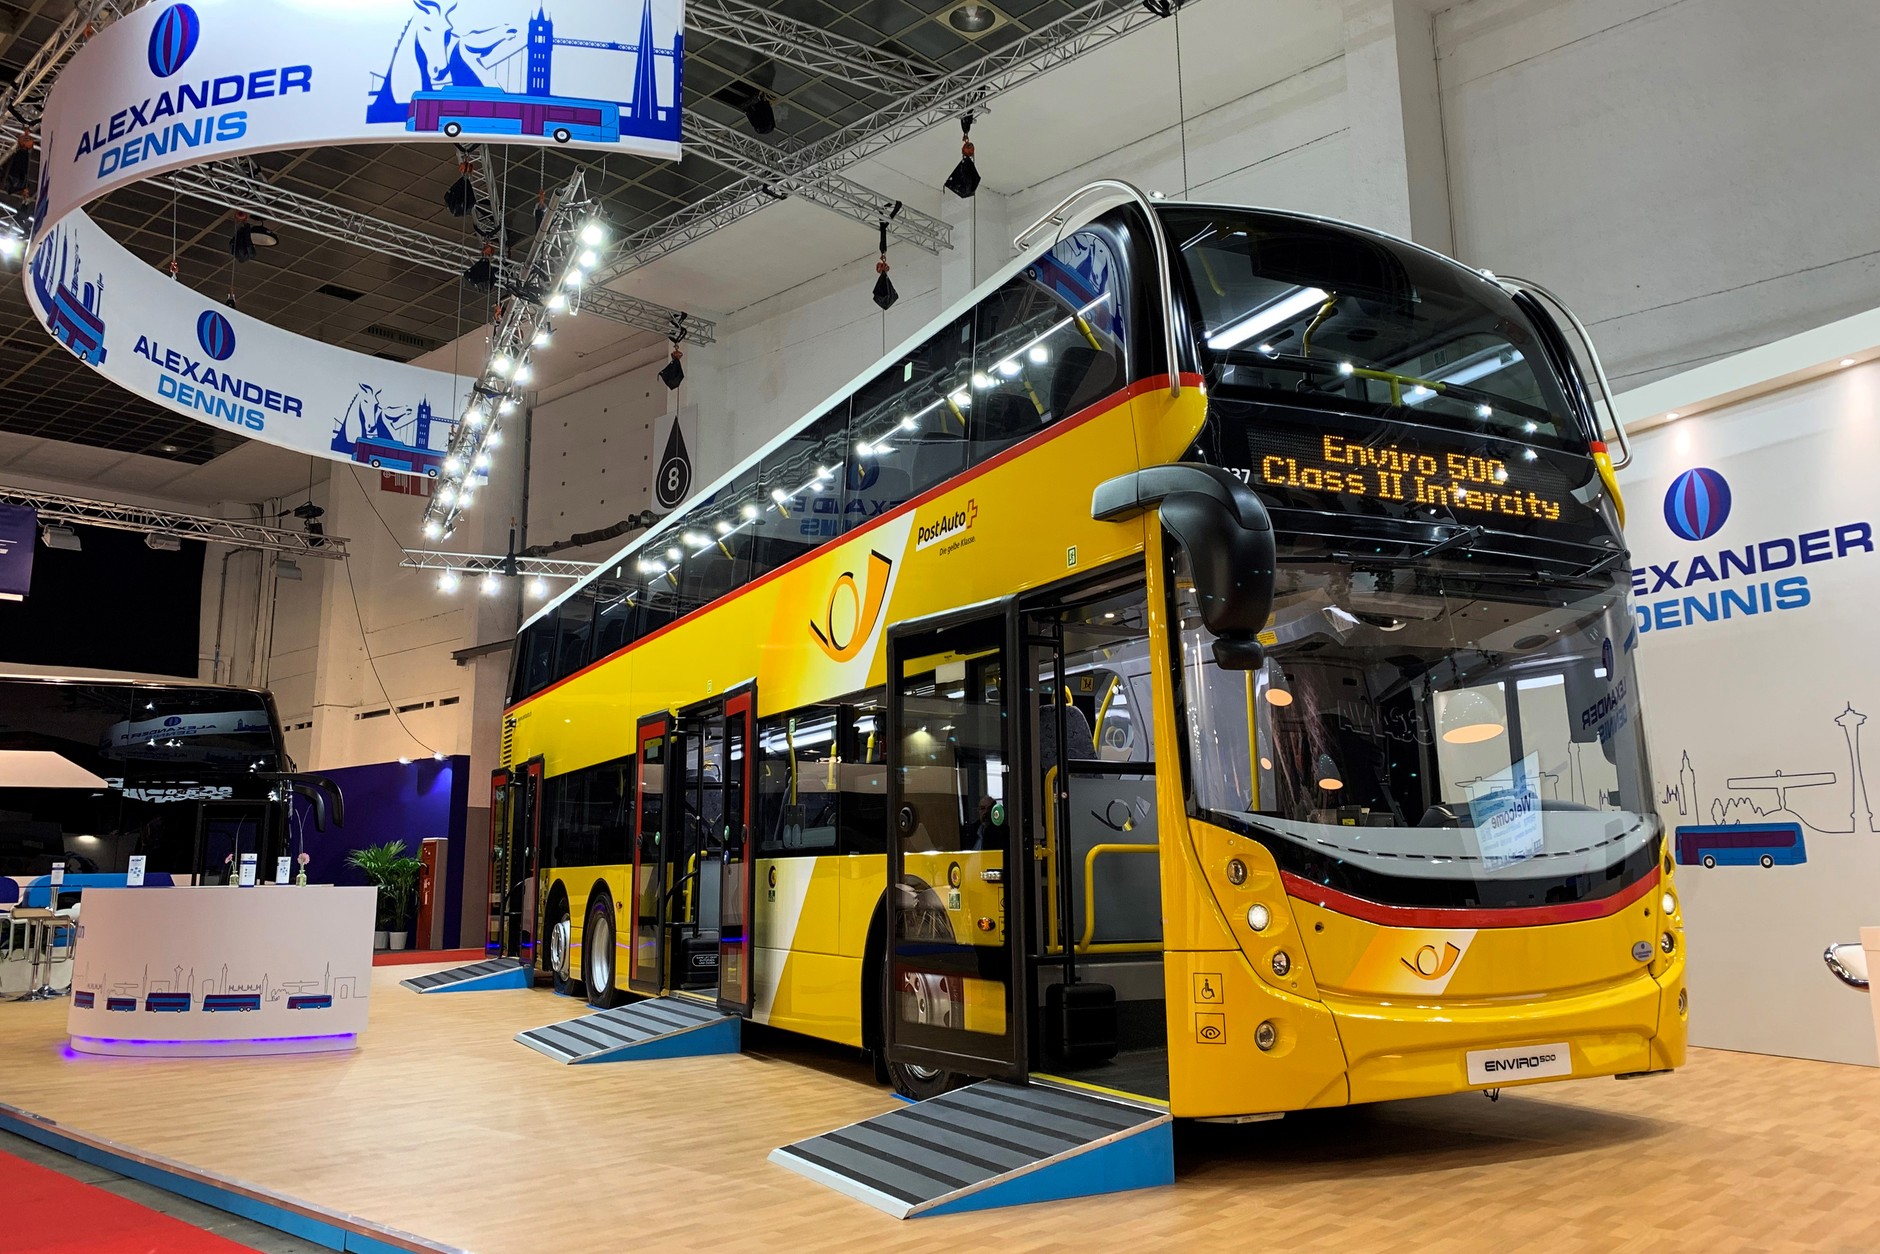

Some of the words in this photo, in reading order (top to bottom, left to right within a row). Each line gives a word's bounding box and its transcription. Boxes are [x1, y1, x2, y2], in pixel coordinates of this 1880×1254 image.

[73, 64, 313, 163] ALEXANDER
[97, 111, 248, 179] DENNIS
[132, 334, 303, 418] ALEXANDER
[157, 373, 265, 432] DENNIS
[667, 466, 680, 491] 8
[1222, 466, 1251, 484] 37
[1323, 434, 1437, 476] Enviro
[1447, 453, 1507, 485] 500
[1262, 455, 1367, 495] Class
[1377, 470, 1404, 500] II
[1413, 475, 1560, 521] Intercity
[917, 510, 966, 546] PostAuto
[939, 547, 949, 556] Die
[947, 541, 961, 556] gelbe
